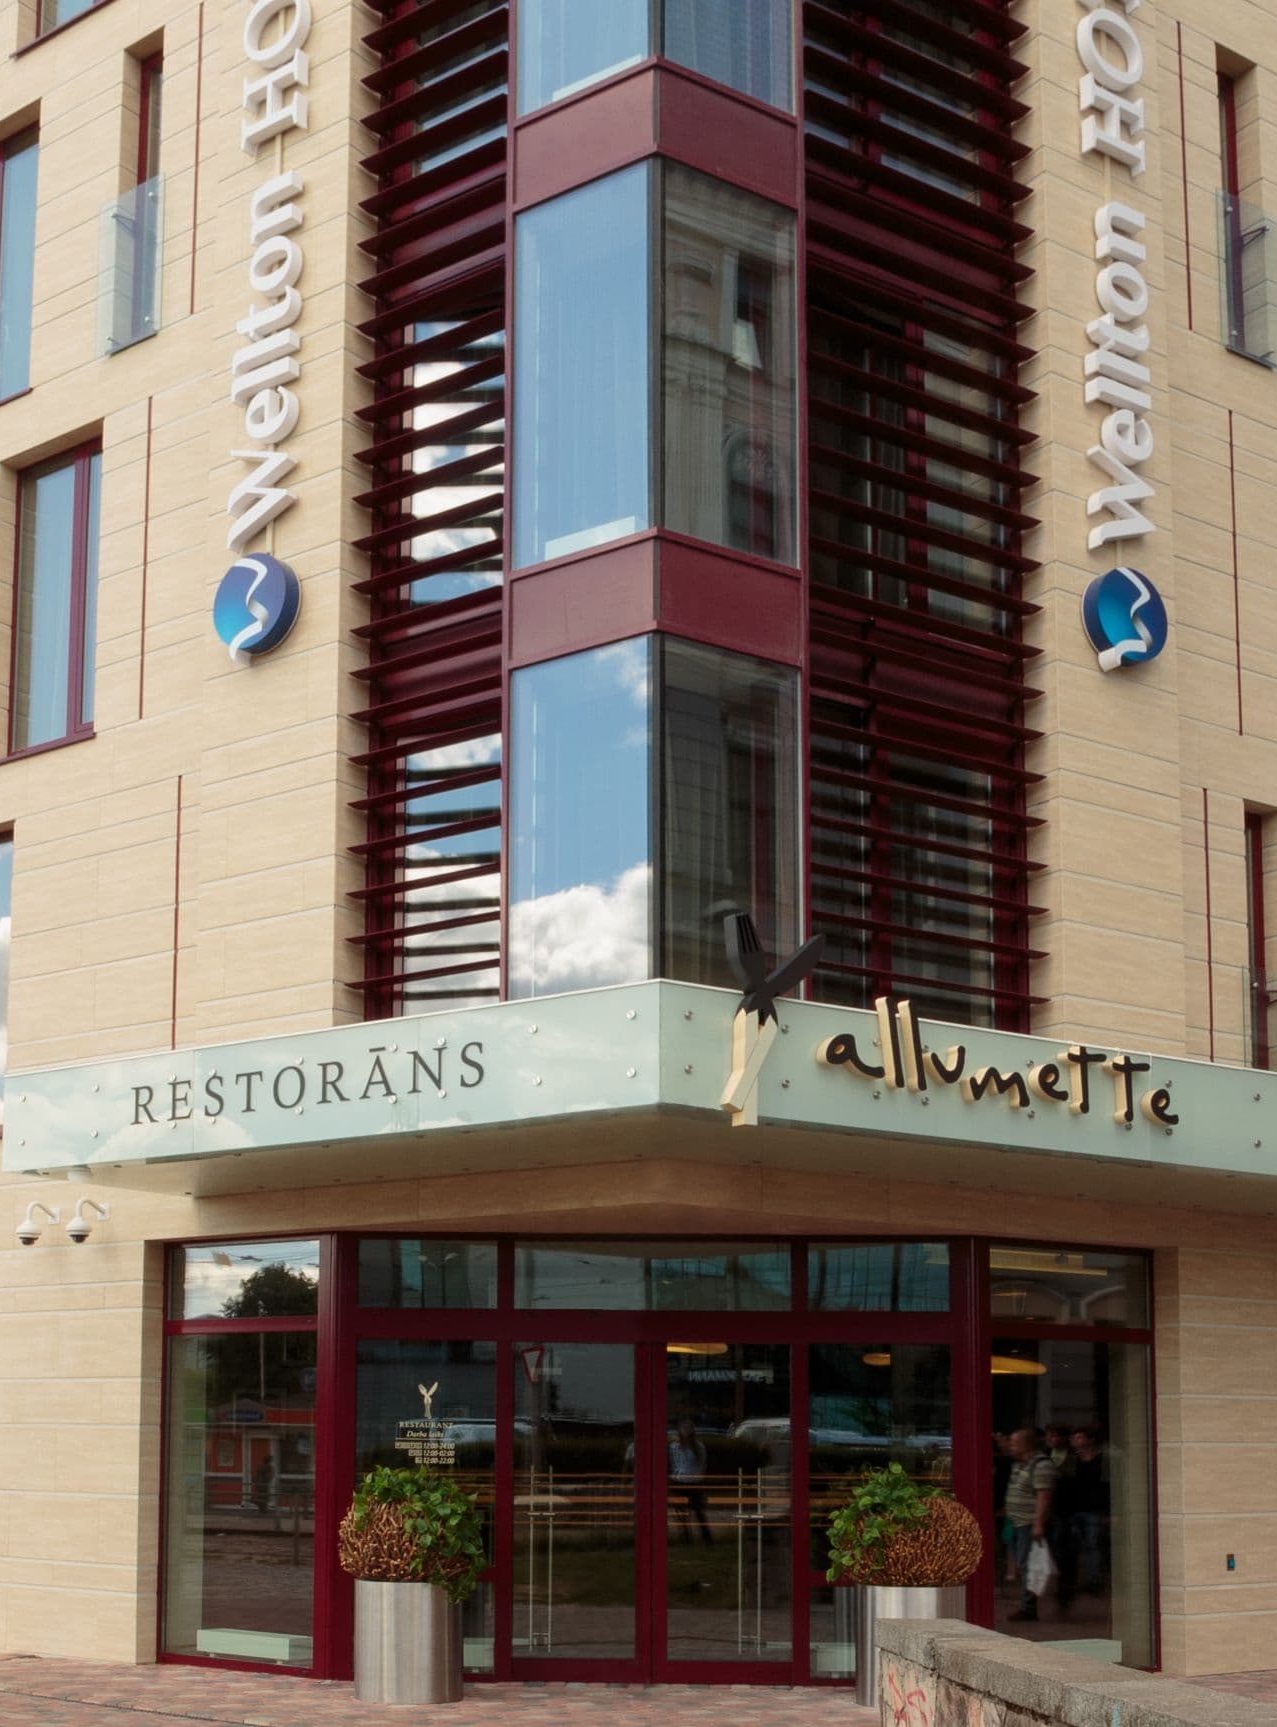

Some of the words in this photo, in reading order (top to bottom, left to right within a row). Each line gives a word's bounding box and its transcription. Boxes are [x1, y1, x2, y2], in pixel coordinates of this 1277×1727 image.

[227, 170, 304, 554] Wellton
[1085, 202, 1156, 552] Wellton
[130, 1041, 485, 1125] RESTORĀNS
[816, 996, 1179, 1127] allumette
